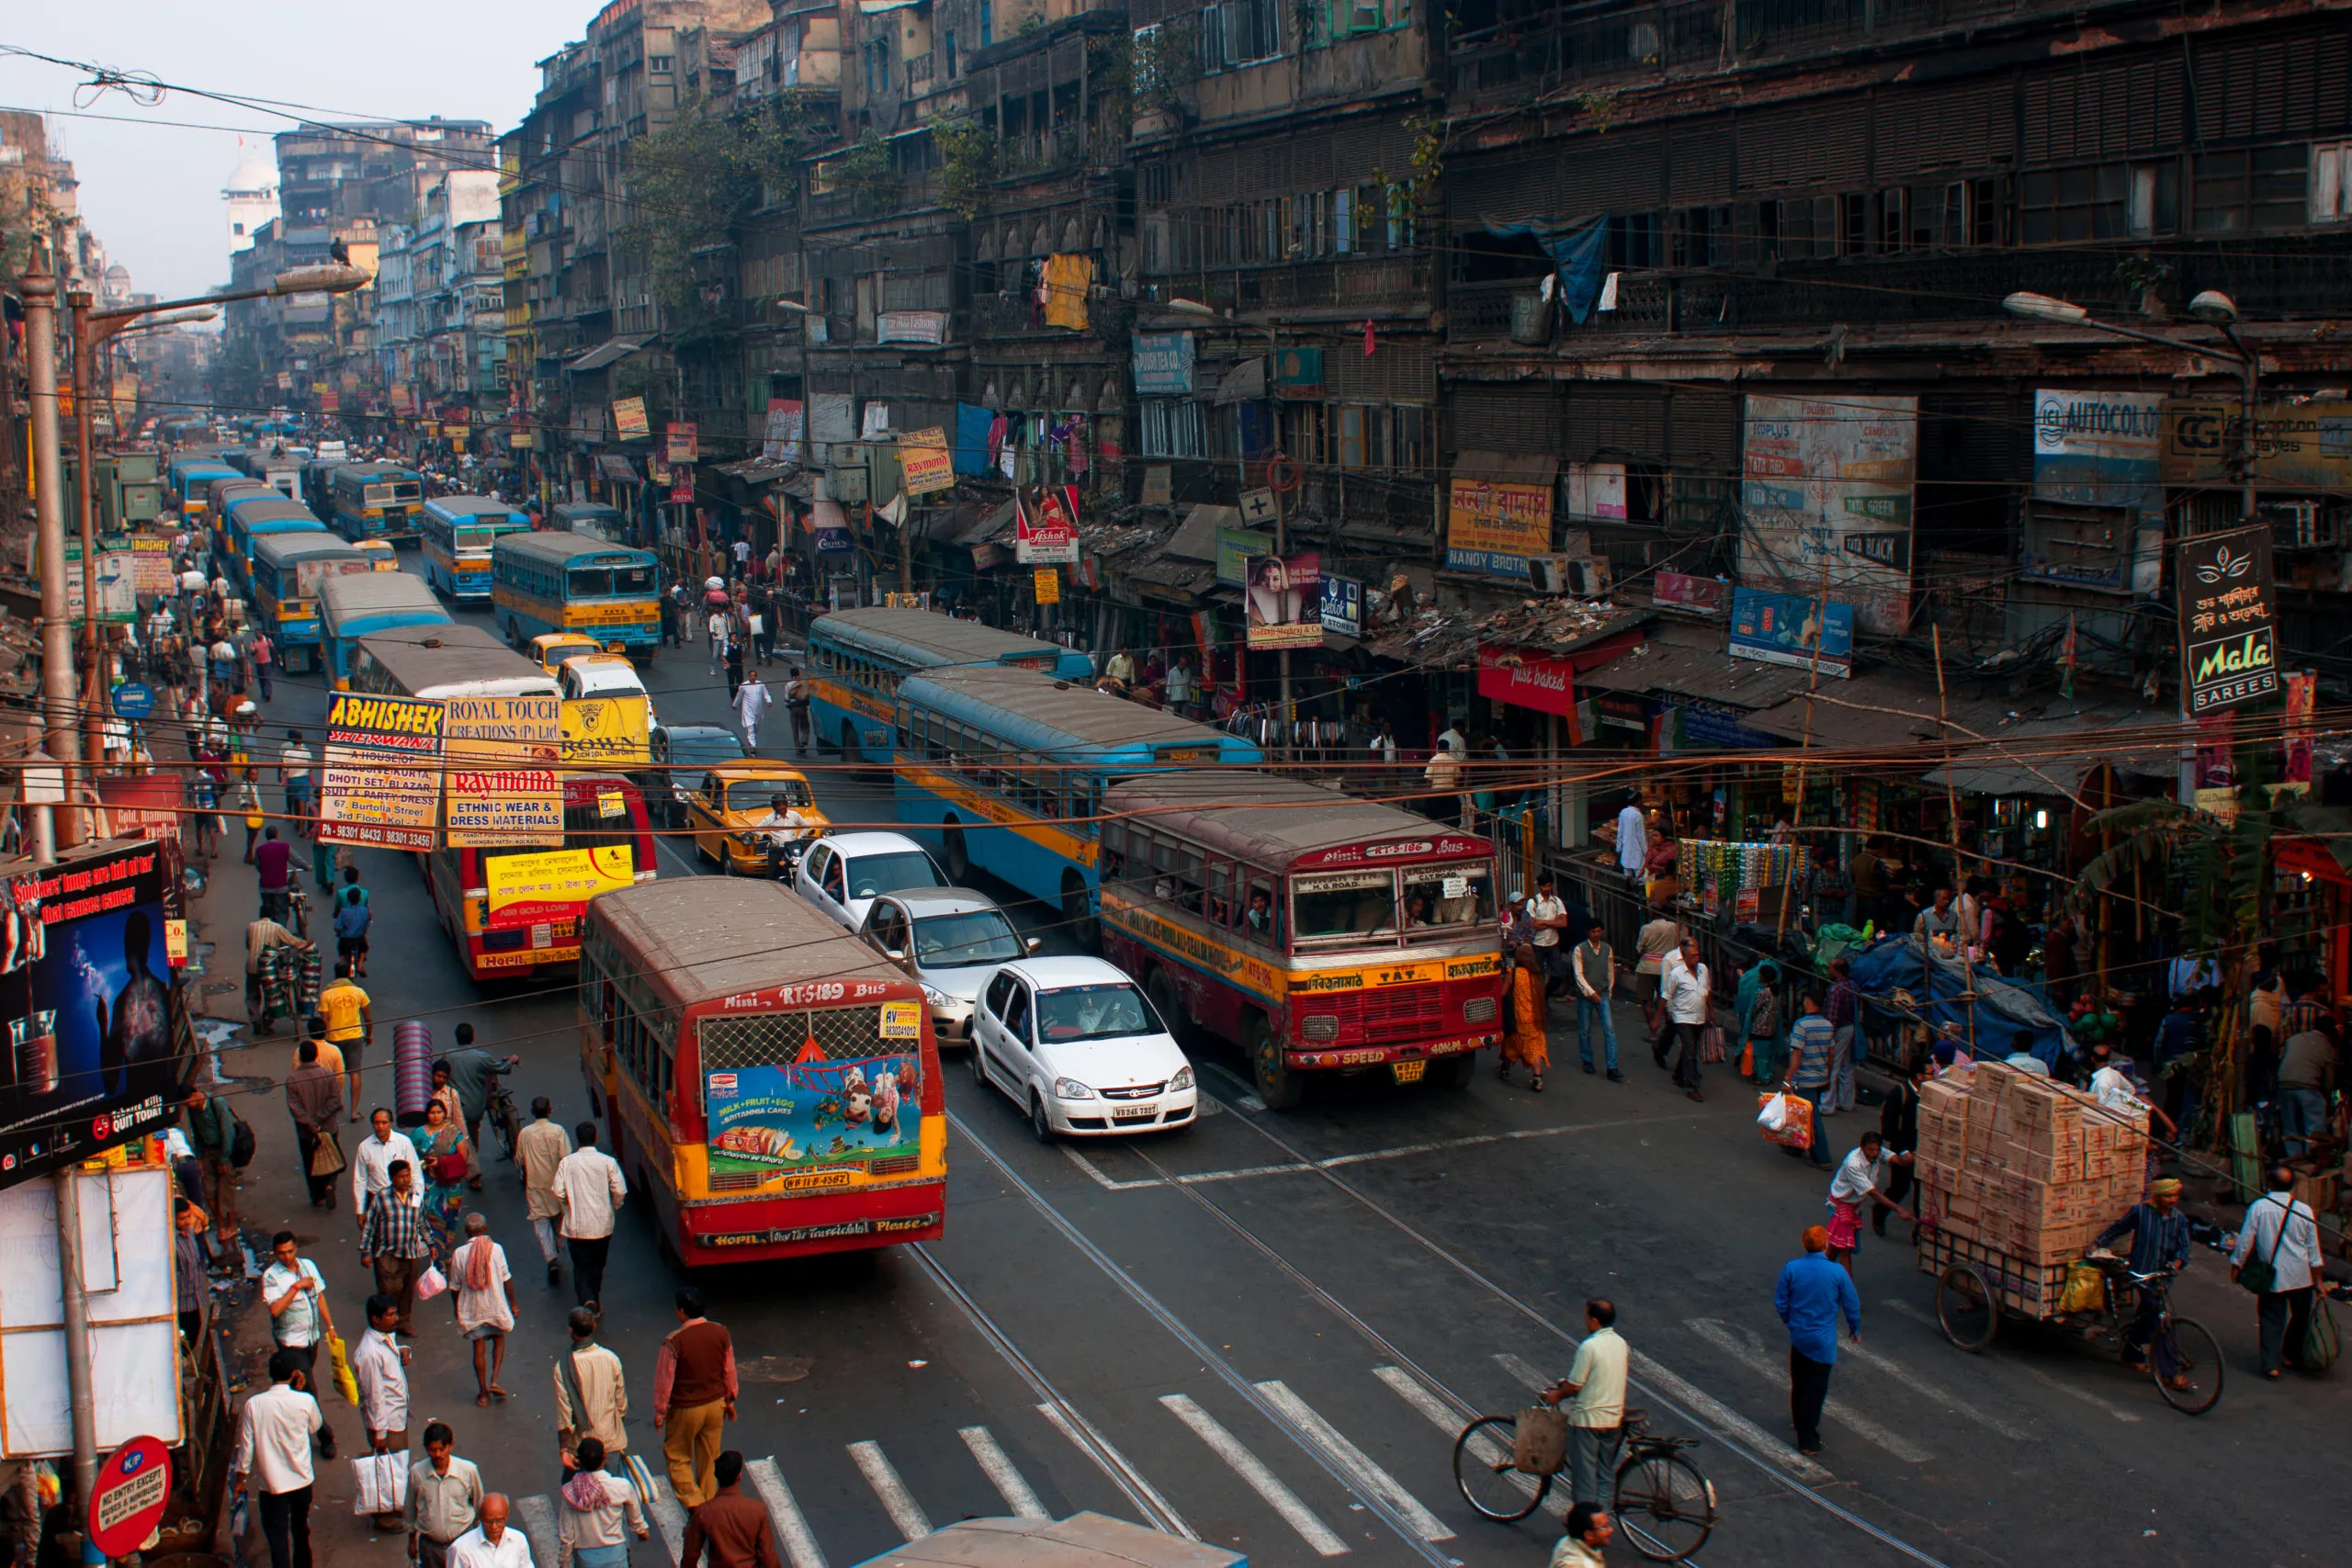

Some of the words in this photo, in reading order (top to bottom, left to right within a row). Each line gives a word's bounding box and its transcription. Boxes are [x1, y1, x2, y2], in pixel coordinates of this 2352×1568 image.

[1753, 423, 1790, 438] ECOPLUS
[907, 455, 948, 474] Raymond
[1030, 529, 1066, 543] Ashok
[1866, 537, 1894, 562] BLACK
[1449, 550, 1488, 570] NANDY
[1328, 618, 1355, 633] STORES
[2197, 634, 2271, 684] Mala
[1533, 665, 1566, 692] baked
[2197, 675, 2273, 706] SAREES
[330, 696, 445, 736] ABHISHEK
[449, 700, 500, 720] ROYAL
[505, 700, 560, 720] TOUCH
[328, 729, 436, 750] SHERWANI
[448, 723, 516, 739] CREATIONS
[519, 724, 537, 740] (P)
[328, 773, 361, 785] DHOTI
[454, 770, 556, 801] Raymond
[324, 785, 350, 796] SUIT
[401, 795, 435, 806] DRESS
[336, 810, 353, 820] 3rd
[394, 806, 424, 817] Street
[458, 802, 502, 813] ETHNIC
[505, 802, 540, 812] WEAR
[544, 802, 551, 812] &
[450, 816, 489, 826] DRESS
[492, 815, 559, 825] MATERIALS
[322, 823, 332, 836] Ph
[337, 825, 358, 839] 98301
[386, 830, 408, 843] 98301
[409, 832, 431, 847] 33456
[62, 871, 92, 894] lungs
[92, 865, 109, 886] are
[109, 859, 128, 881] full
[128, 855, 138, 877] of
[1332, 881, 1361, 889] ROAD.
[41, 901, 64, 925] that
[64, 895, 101, 919] causes
[101, 886, 136, 910] cancer
[520, 906, 544, 915] GOLD
[854, 983, 887, 998] Bus
[885, 1010, 897, 1024] AV
[885, 1024, 917, 1037] 9830241012
[1341, 1051, 1385, 1065] SPEED
[144, 1094, 163, 1110] Kills
[112, 1113, 134, 1133] QUIT
[135, 1104, 163, 1124] TODAY
[876, 1219, 922, 1232] Please
[102, 1494, 113, 1506] NO
[113, 1483, 135, 1498] ENTRY
[136, 1469, 162, 1489] EXCEPT
